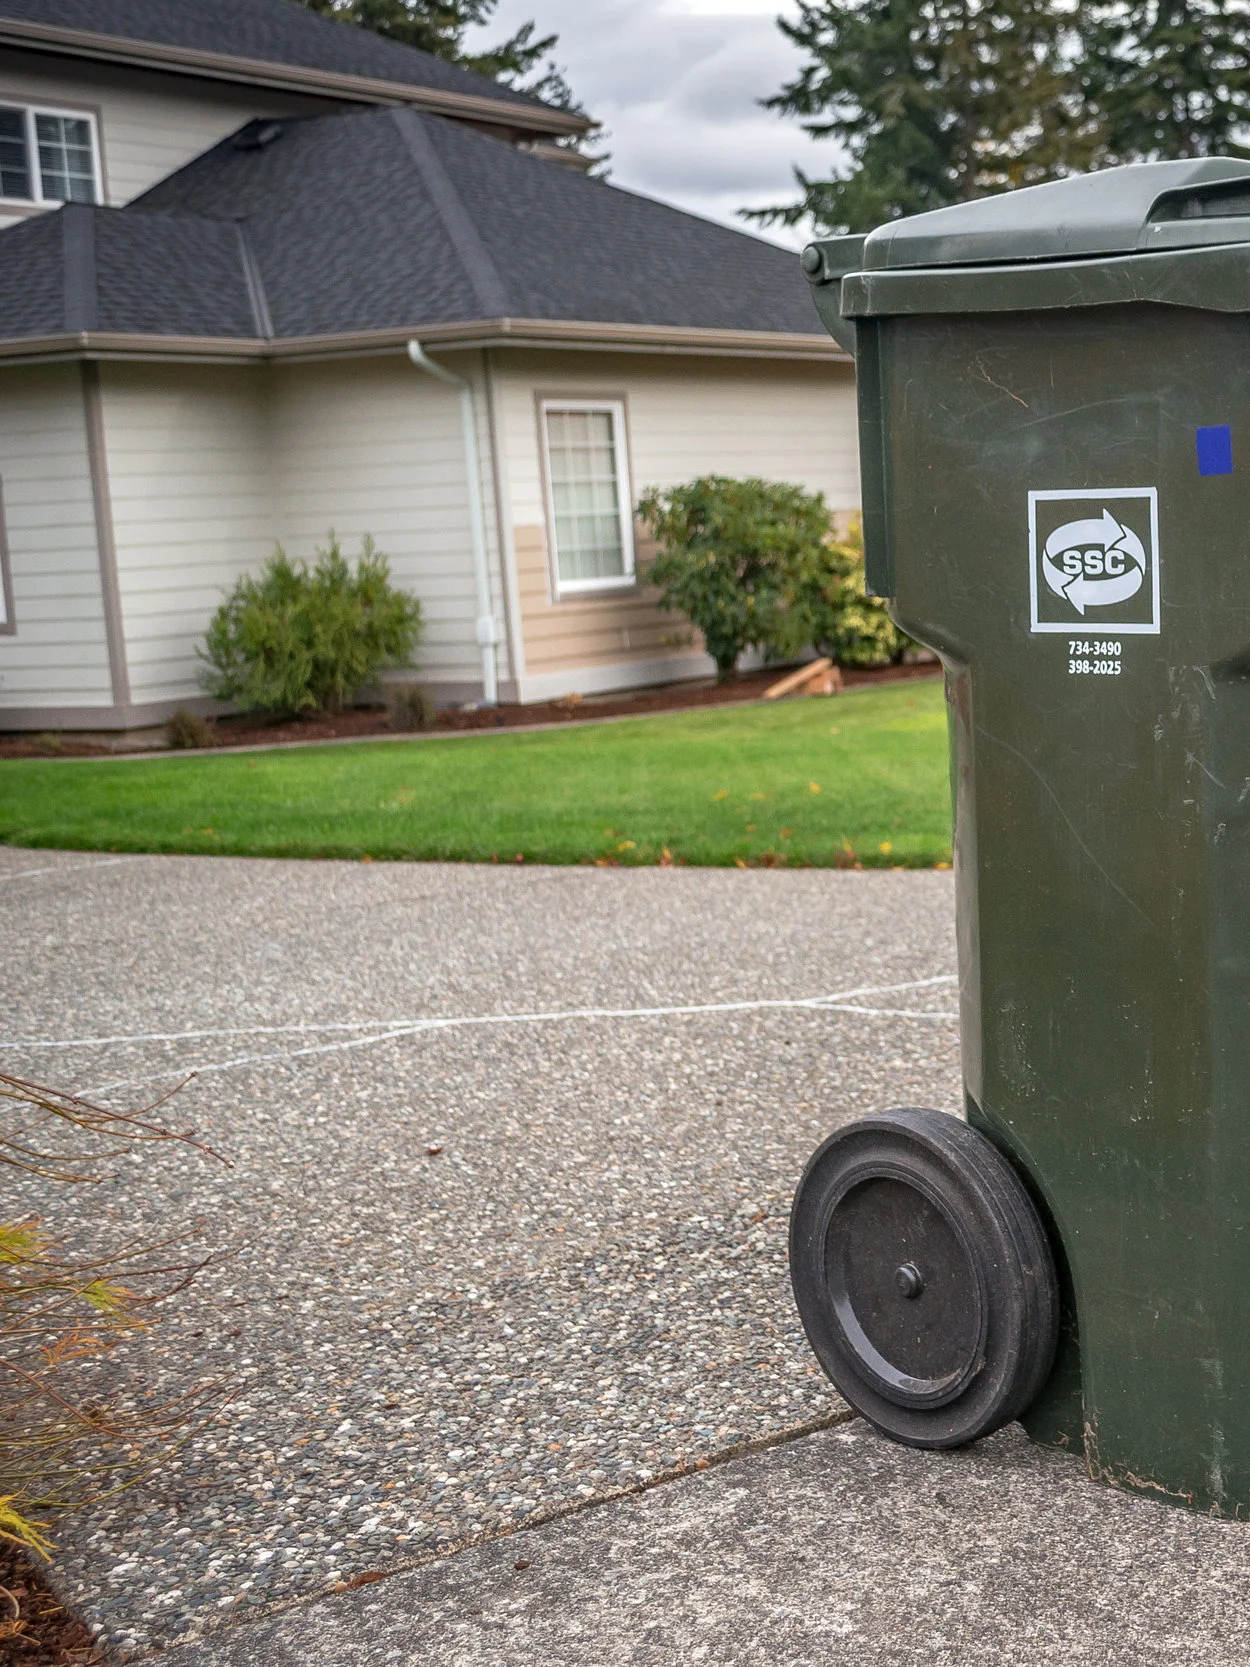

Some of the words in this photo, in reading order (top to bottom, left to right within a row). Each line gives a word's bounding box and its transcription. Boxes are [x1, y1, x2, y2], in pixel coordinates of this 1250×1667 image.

[1063, 549, 1125, 575] SSC
[1068, 640, 1122, 656] 734-3490
[1068, 659, 1122, 675] 398-2025
